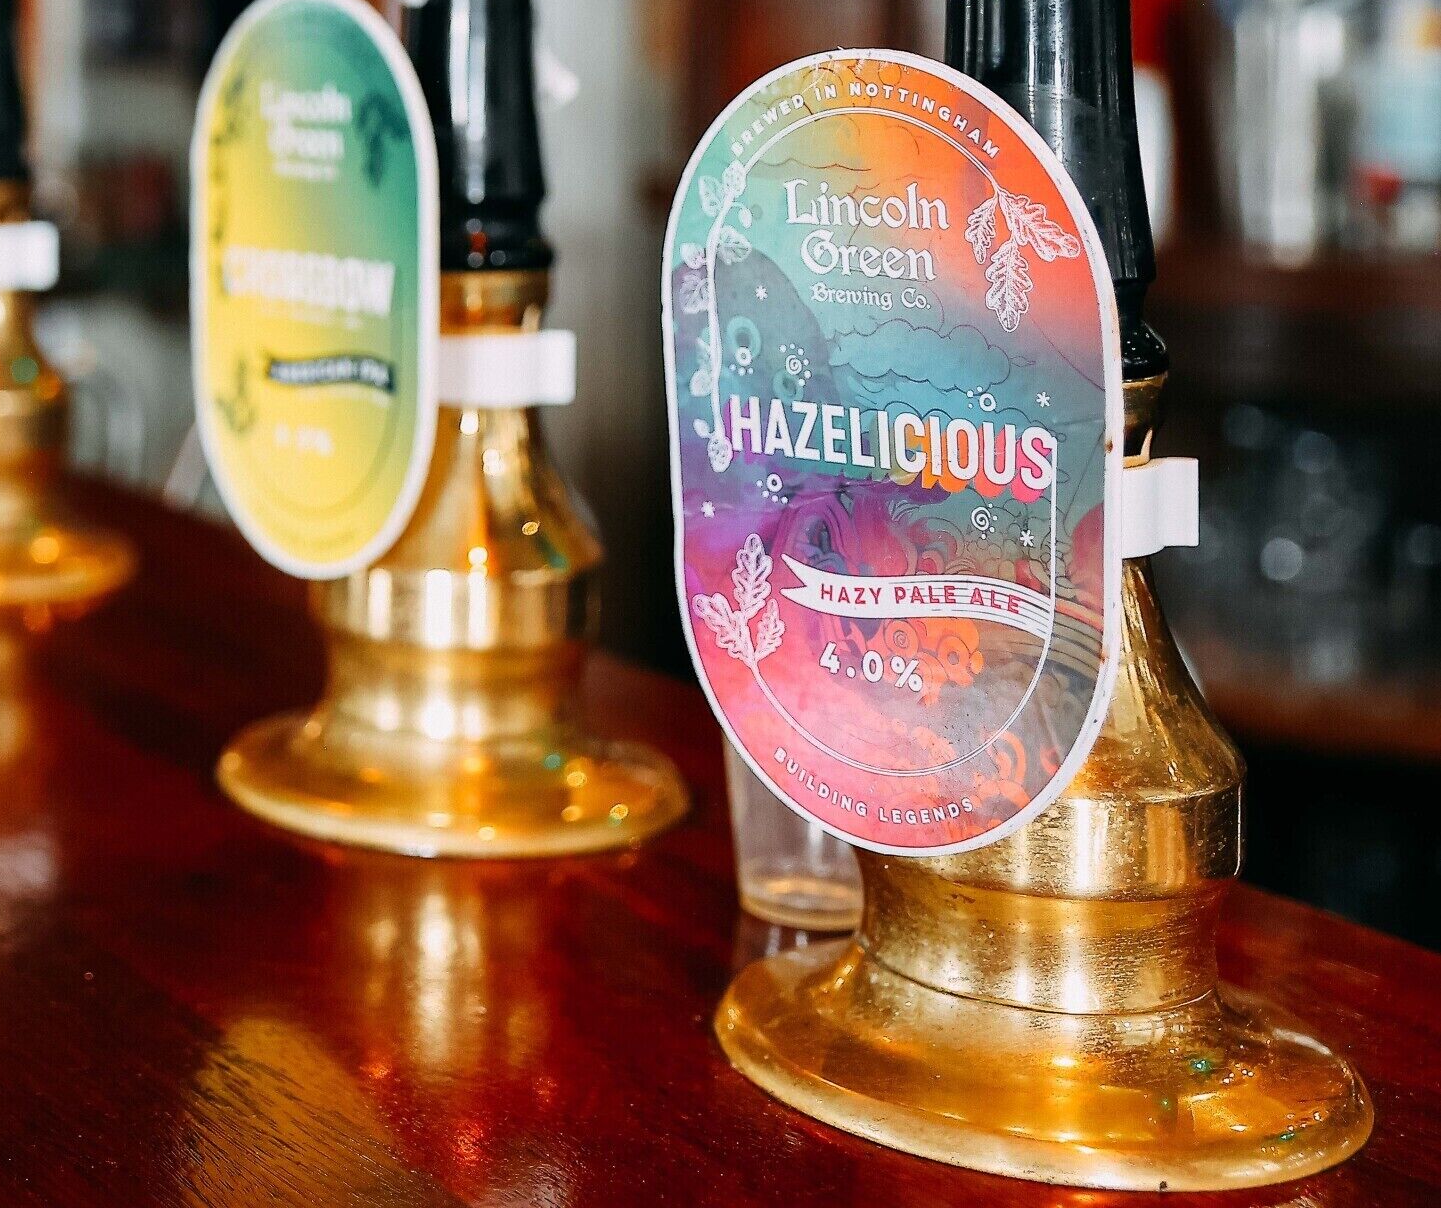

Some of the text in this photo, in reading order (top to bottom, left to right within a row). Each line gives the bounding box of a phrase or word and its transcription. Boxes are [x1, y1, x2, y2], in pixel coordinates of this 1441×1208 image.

[732, 81, 1000, 159] BREWED IN NOTTINGHAM
[783, 177, 950, 231] Lincoln
[800, 229, 937, 282] Green
[810, 282, 931, 312] Brewing Co.
[729, 393, 1055, 490] HAZELICIOUS
[819, 583, 1022, 616] HAZY PALE ALE
[818, 641, 923, 693] 4.0%
[773, 746, 975, 826] BUILDING LEGENDS
